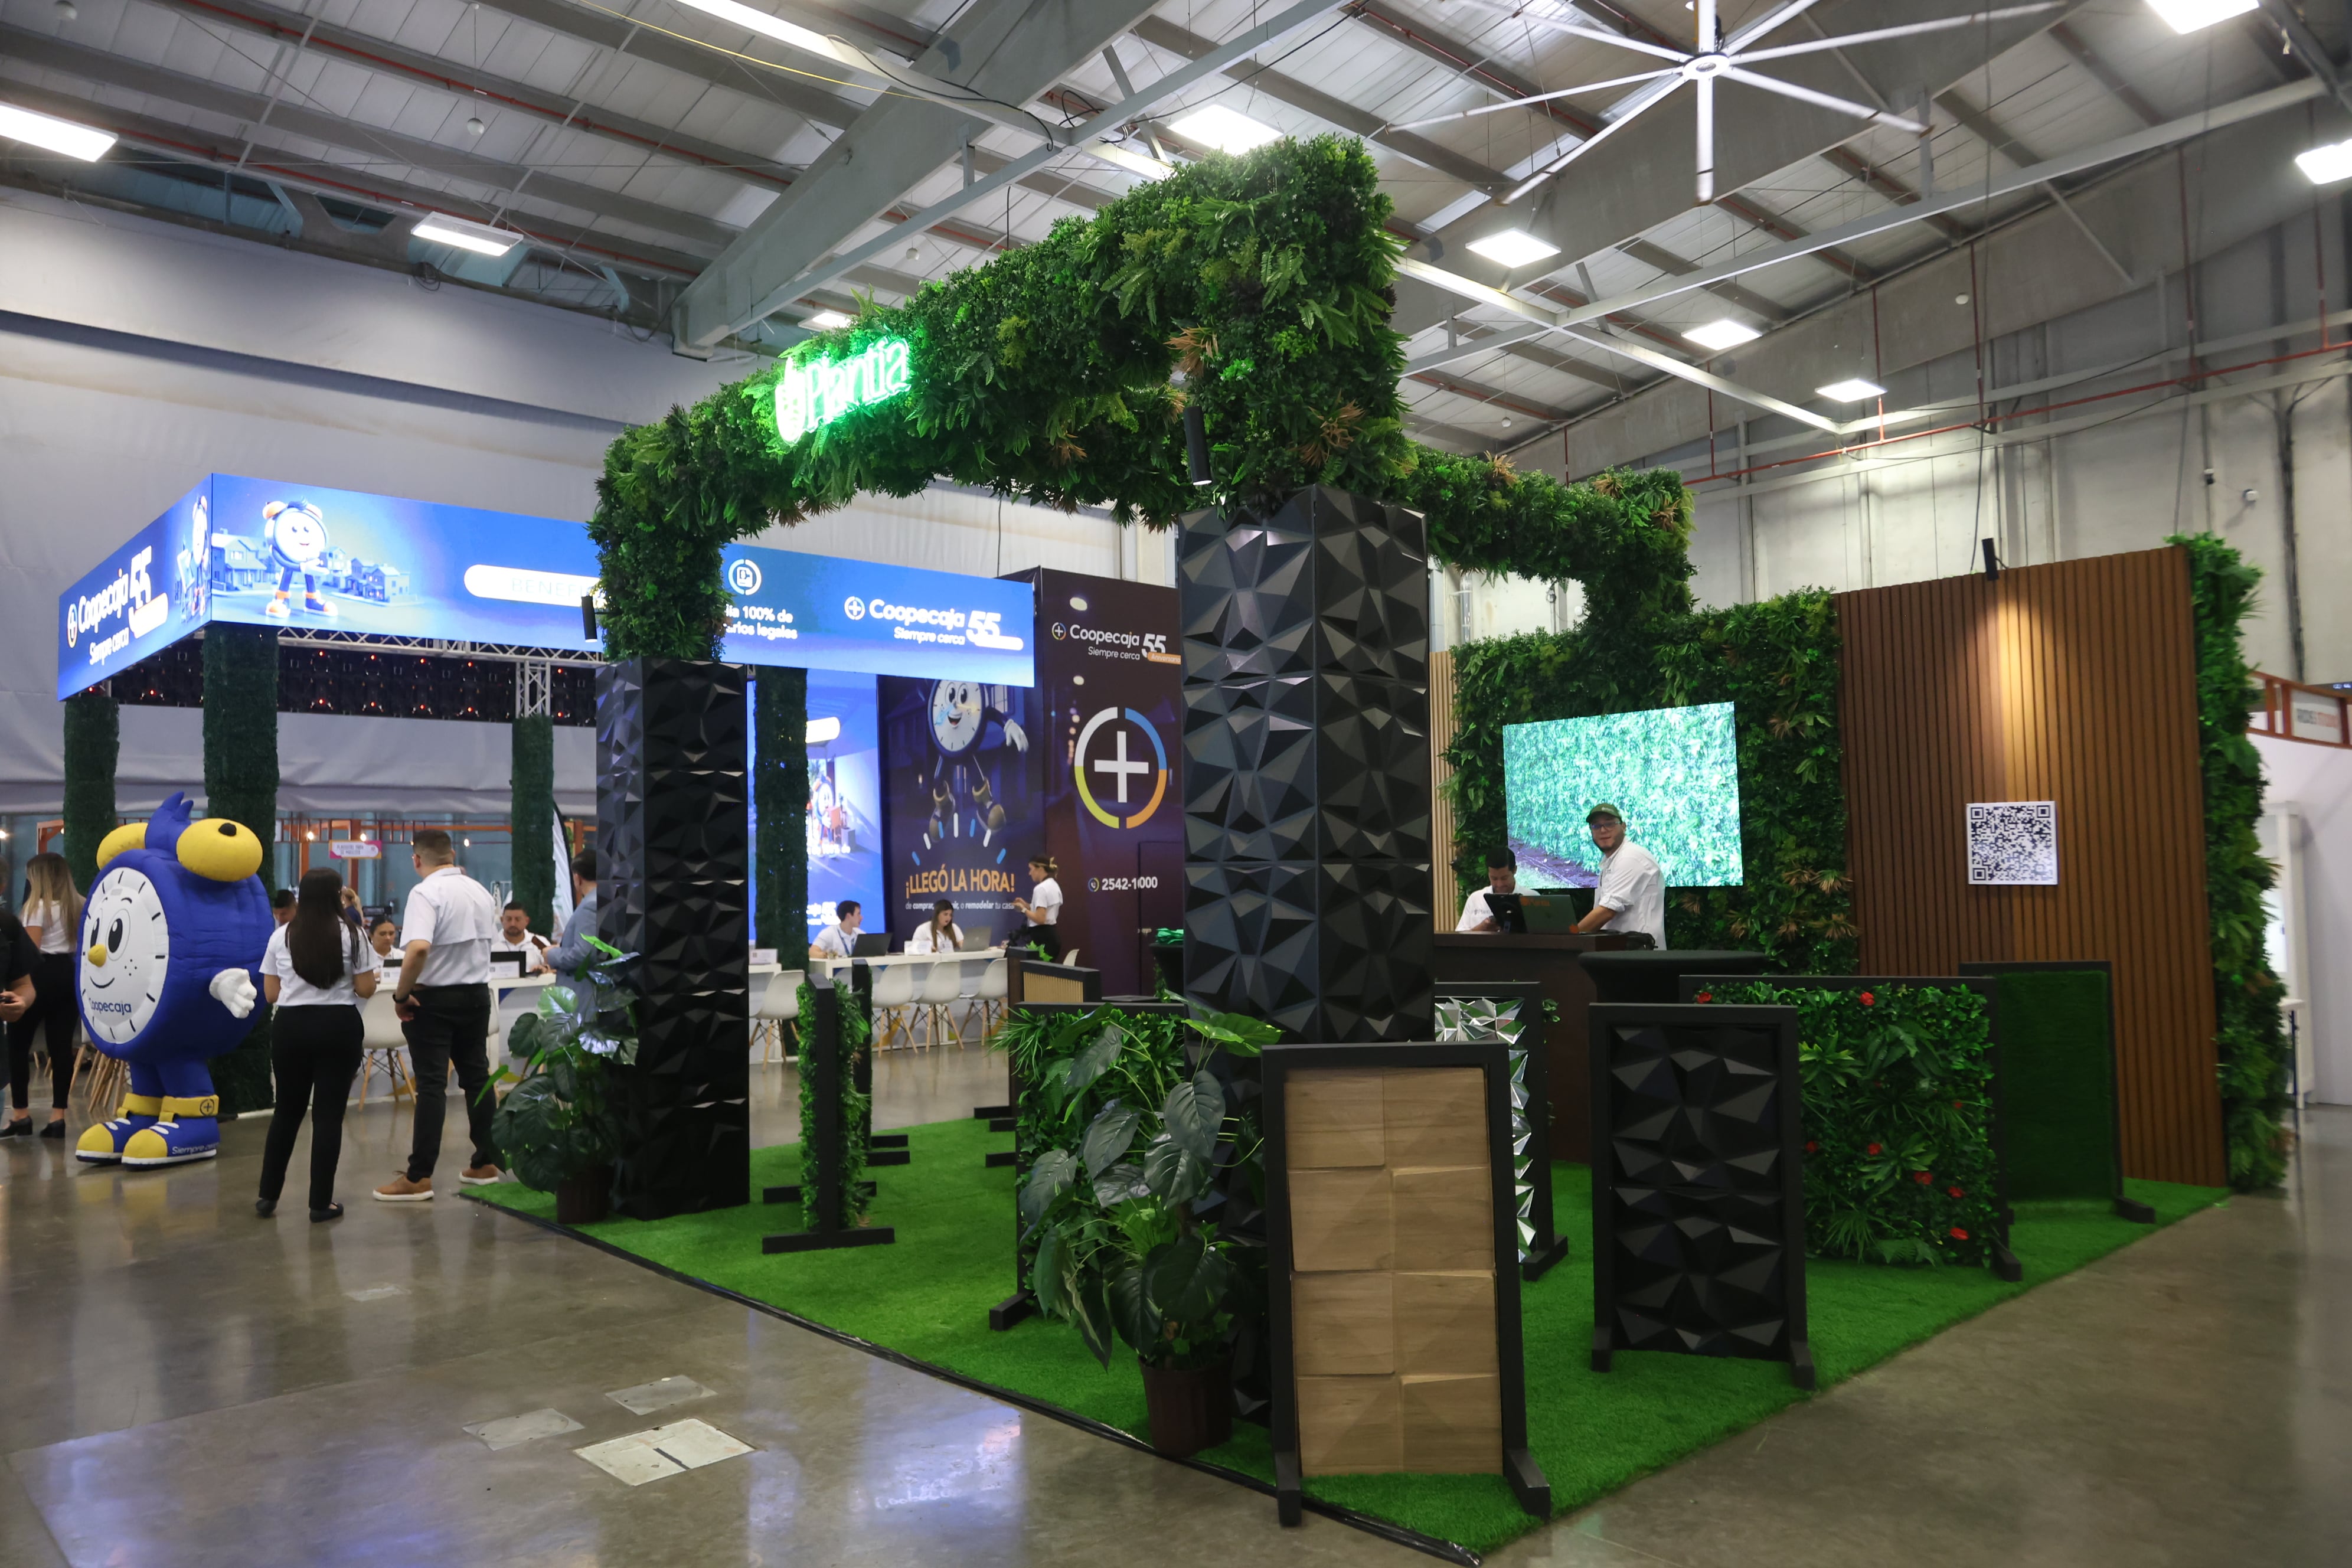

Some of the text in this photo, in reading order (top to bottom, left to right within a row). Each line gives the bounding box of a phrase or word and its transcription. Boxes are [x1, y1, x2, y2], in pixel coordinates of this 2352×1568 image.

[79, 545, 152, 633] Coopecaja 55
[511, 577, 583, 597] BENEFI
[742, 606, 776, 622] 100%
[777, 609, 793, 623] de
[869, 599, 1001, 643] Coopecaja 55
[757, 622, 798, 641] legales
[894, 626, 965, 645] Siempre cerca
[1069, 624, 1167, 658] Coopecaja 55
[1087, 646, 1140, 660] Siempre cerca
[906, 864, 1015, 899] ¡LLEGÓ LA HORA!
[1102, 876, 1158, 891] 2542-1000
[905, 901, 912, 910] de
[965, 900, 994, 910] remodelar
[89, 998, 132, 1015] oopecaja
